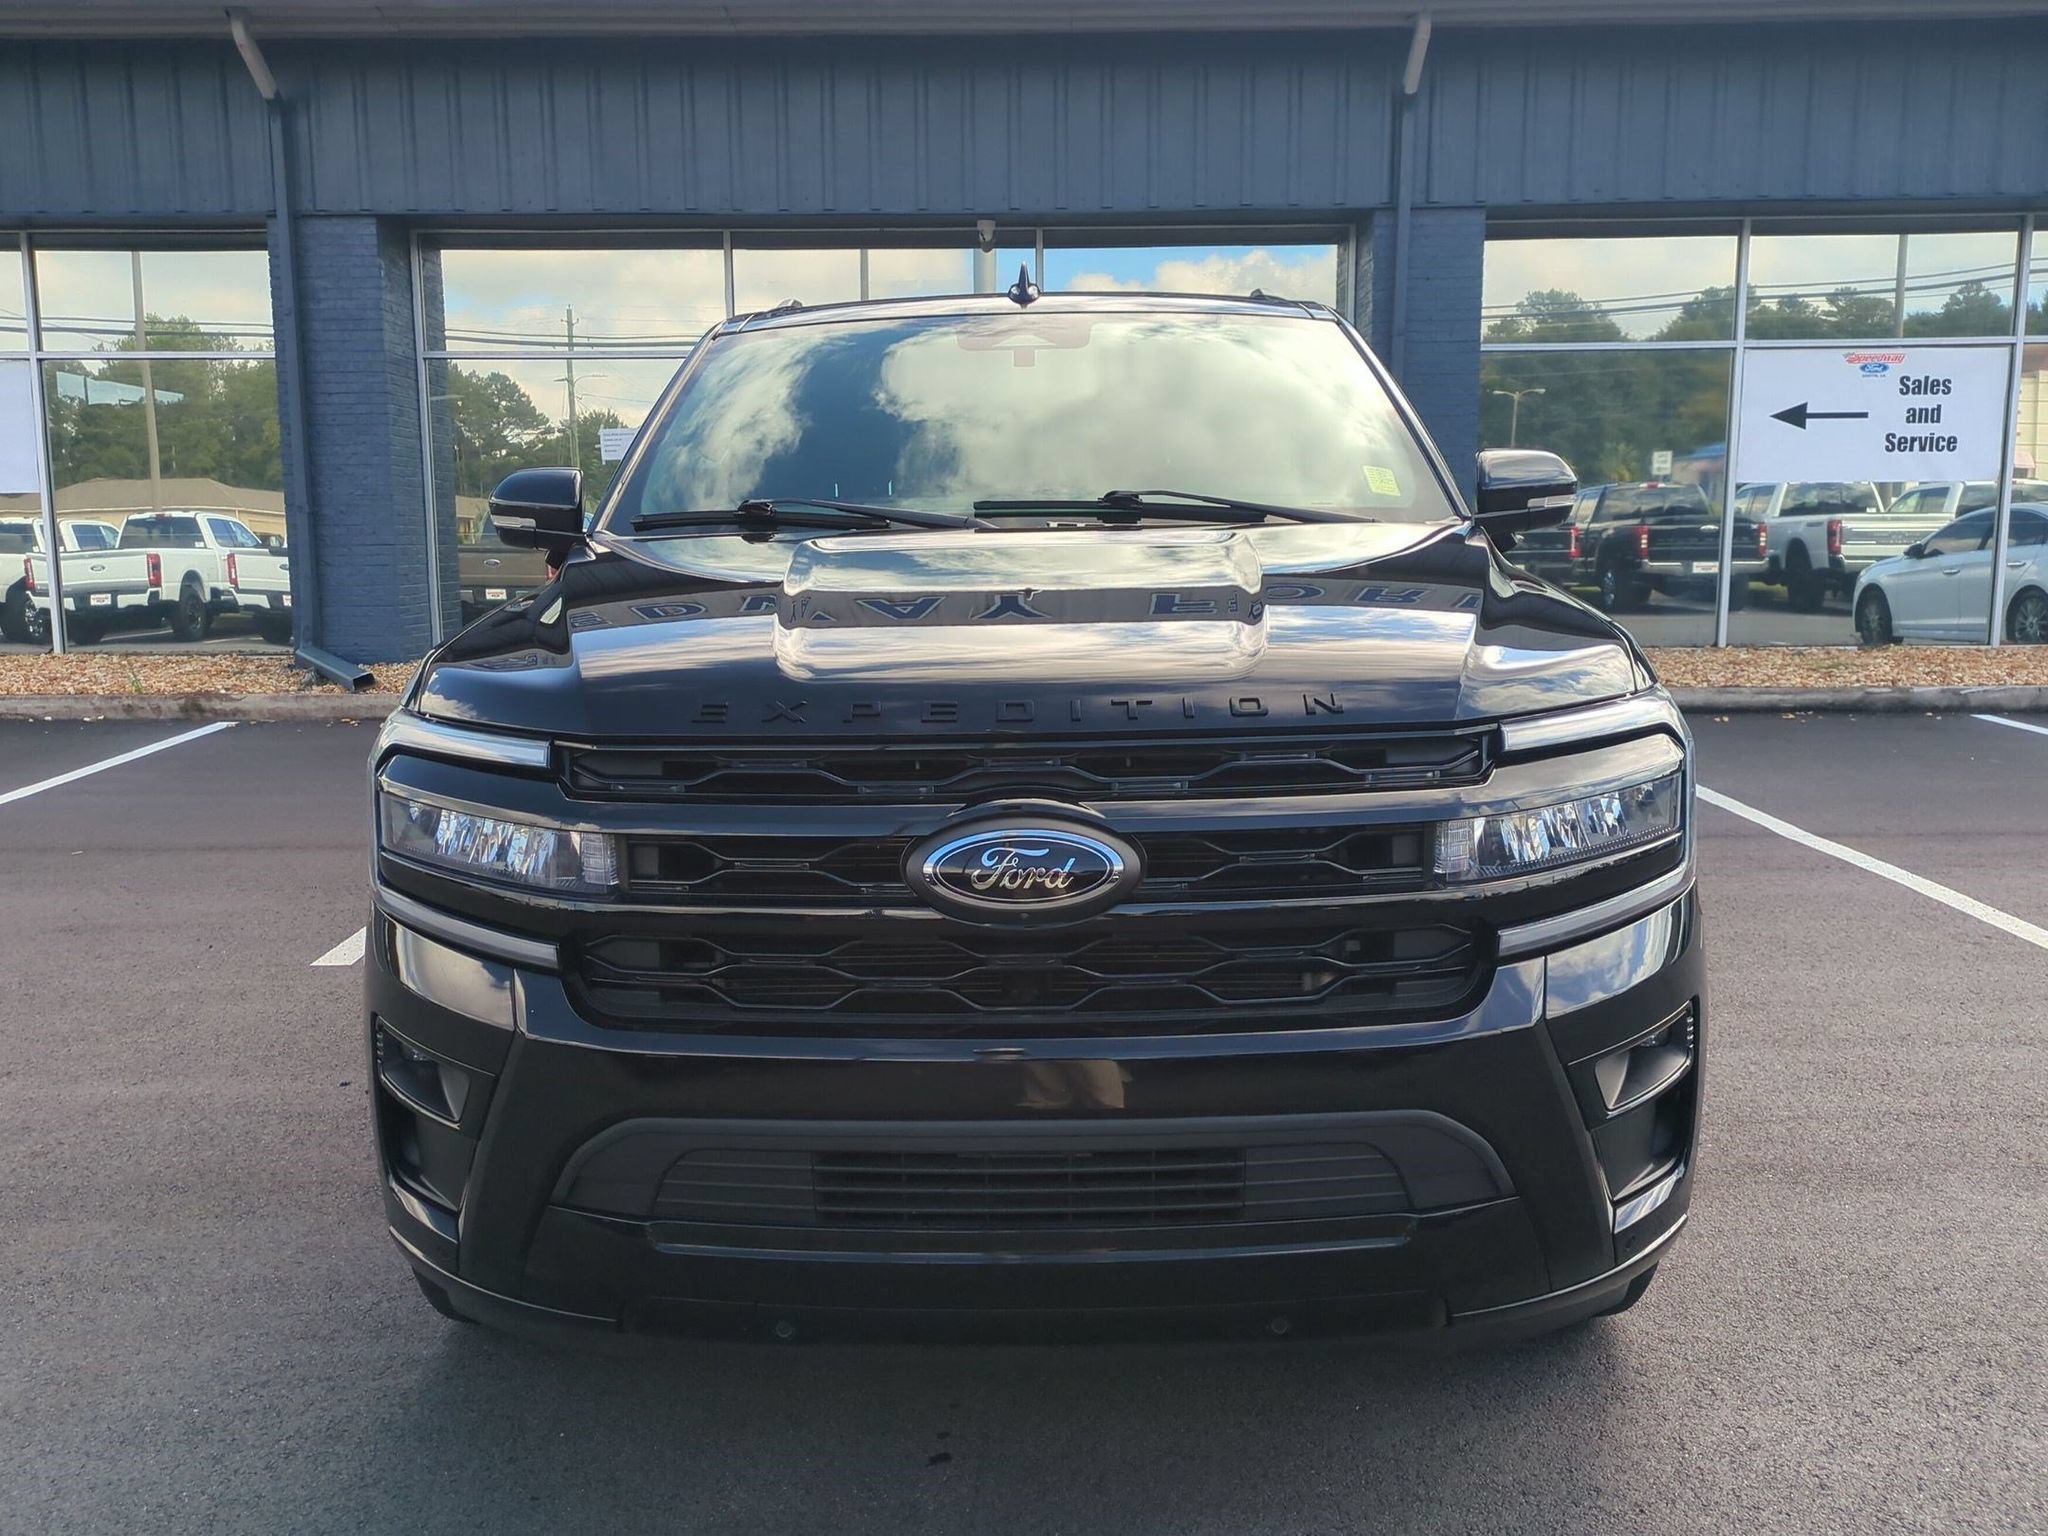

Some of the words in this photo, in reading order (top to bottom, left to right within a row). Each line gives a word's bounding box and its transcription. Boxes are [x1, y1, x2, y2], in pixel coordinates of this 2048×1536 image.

[1899, 375, 1952, 396] Sales
[1905, 404, 1941, 424] and
[1884, 432, 1958, 453] Service
[690, 692, 1346, 724] EXPEDITION
[970, 846, 1076, 890] Ford
